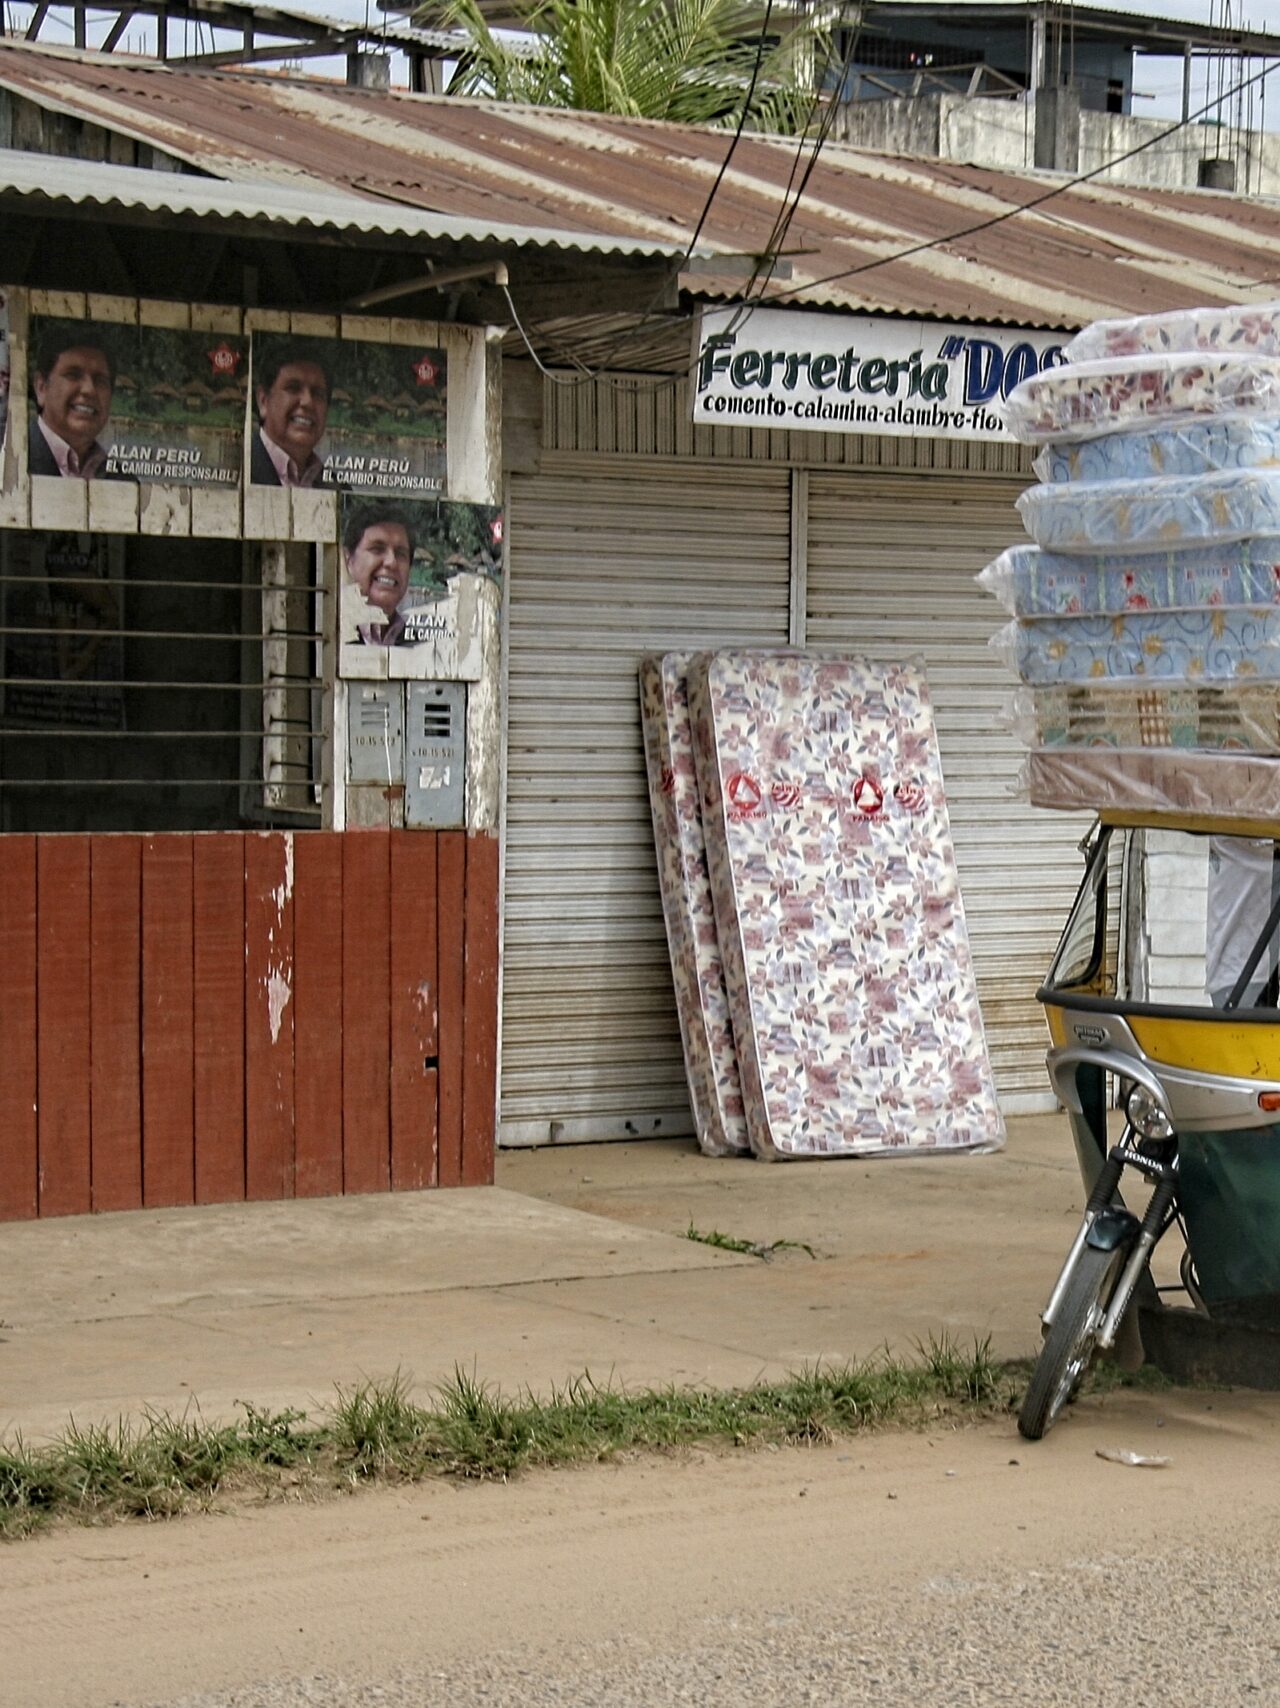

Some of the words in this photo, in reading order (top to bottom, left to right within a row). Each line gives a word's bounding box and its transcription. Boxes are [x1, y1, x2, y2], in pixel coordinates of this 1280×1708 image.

[698, 334, 949, 402] Ferreteria
[107, 444, 152, 460] ALAN
[155, 447, 202, 464] PERÚ
[105, 459, 119, 473] EL
[121, 461, 162, 476] CAMBIO
[164, 464, 239, 483] RESPONSABLE
[323, 455, 365, 470] ALAN
[368, 456, 410, 474] PERÚ
[321, 468, 335, 483] EL
[336, 470, 374, 486] CAMBIO
[375, 473, 443, 491] RESPONSABLE
[405, 613, 446, 628] ALAN
[403, 627, 416, 641] EL
